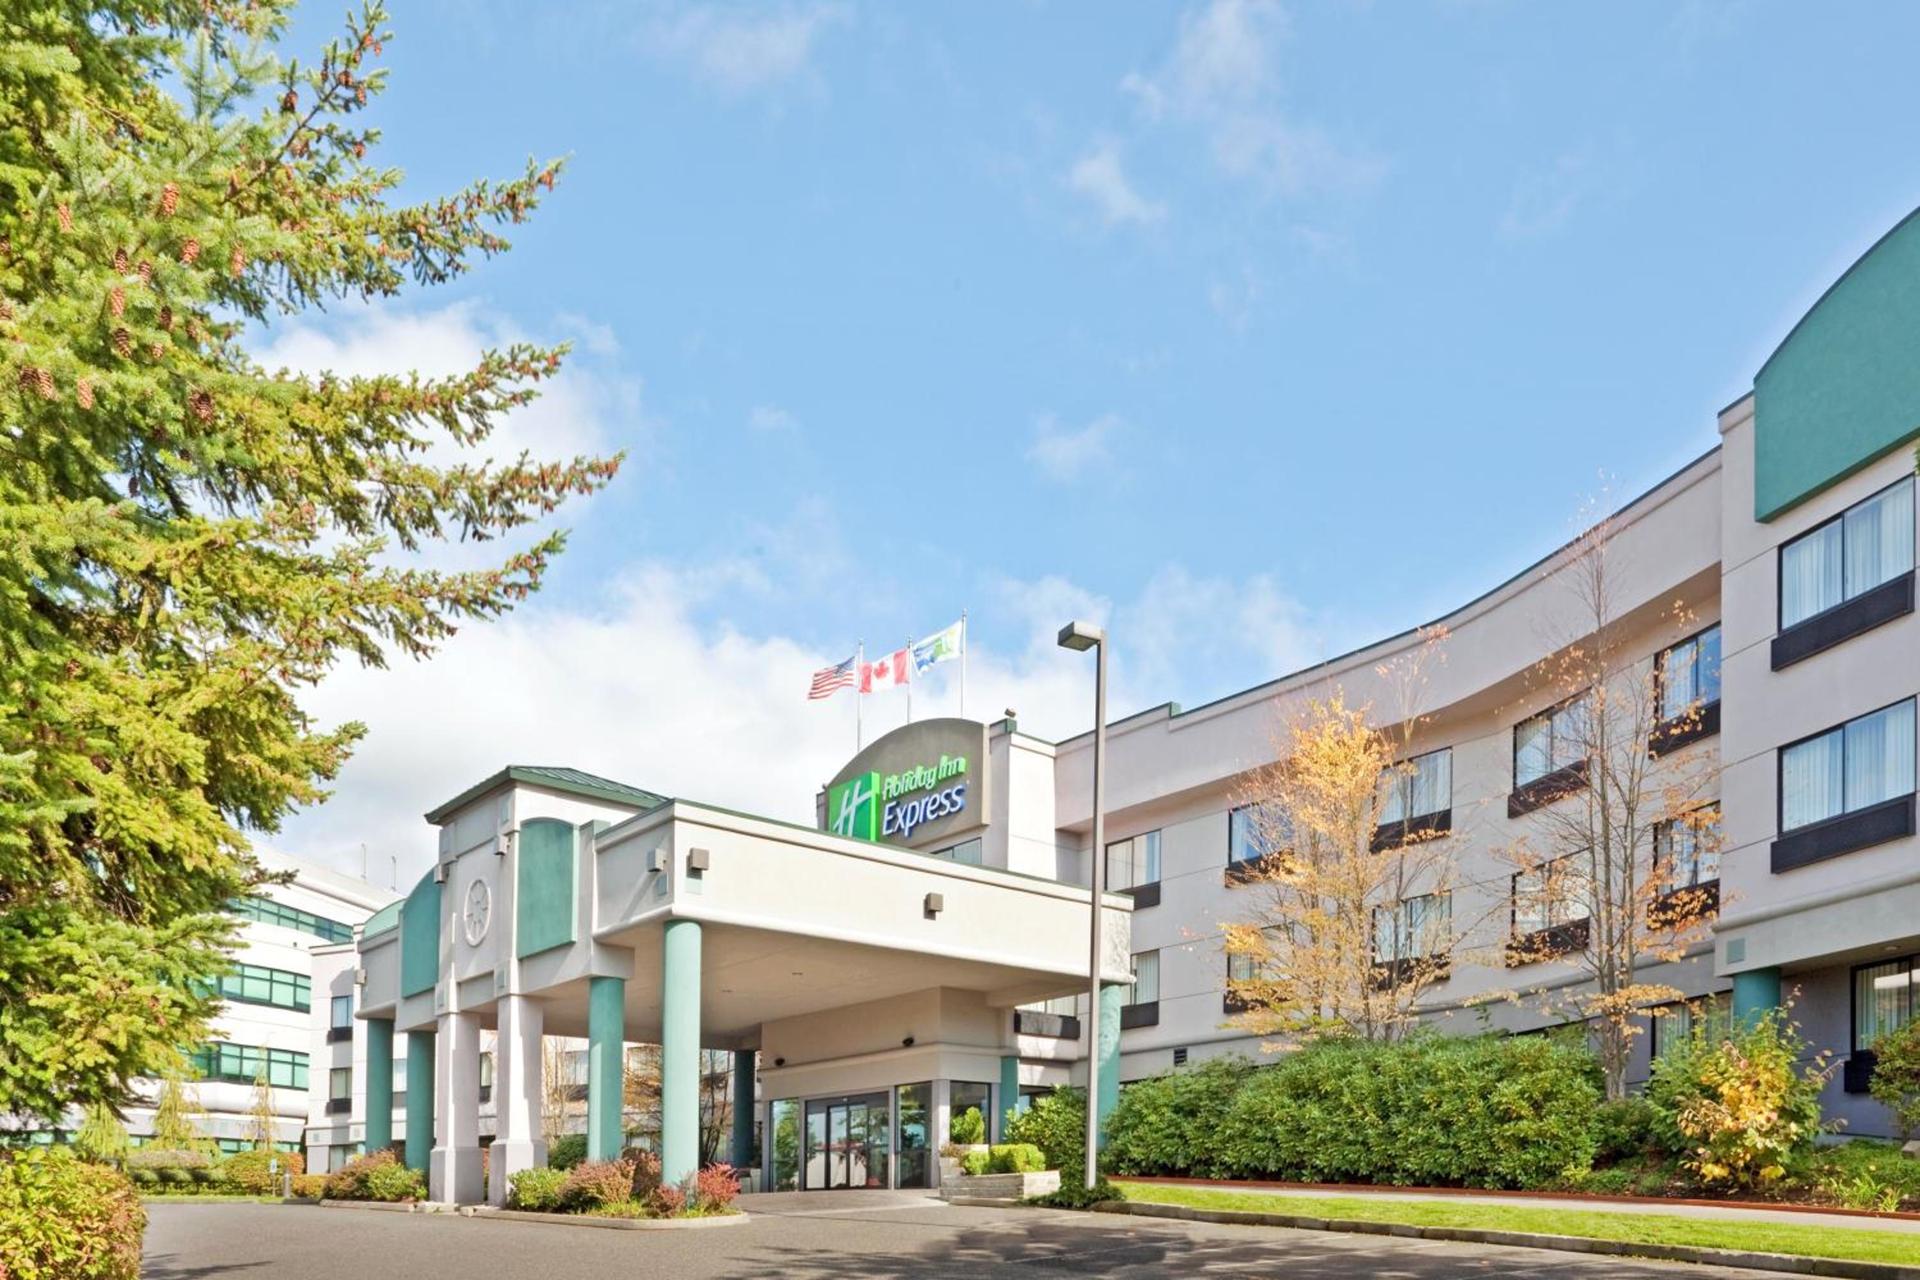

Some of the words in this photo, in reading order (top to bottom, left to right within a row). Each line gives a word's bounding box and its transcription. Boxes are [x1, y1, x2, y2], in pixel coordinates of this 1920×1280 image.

[882, 765, 937, 801] Holiday
[938, 755, 966, 781] Inn
[882, 784, 965, 837] Express
